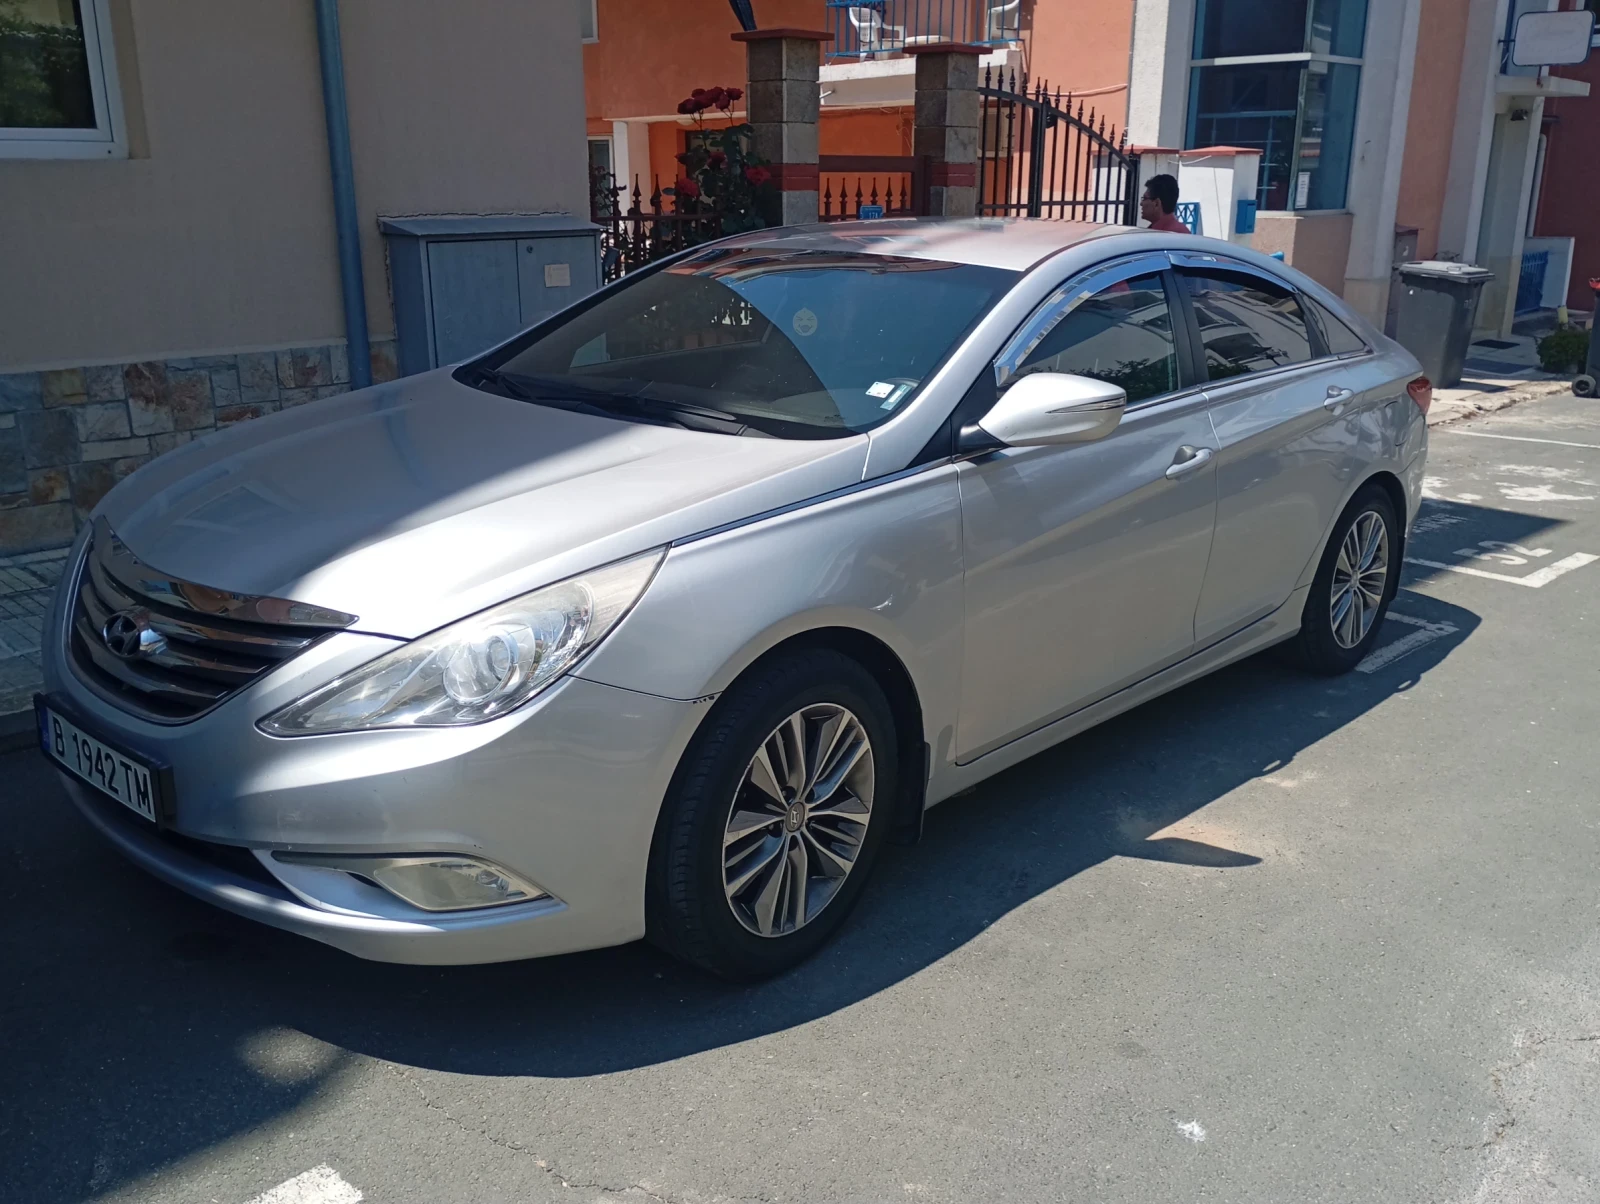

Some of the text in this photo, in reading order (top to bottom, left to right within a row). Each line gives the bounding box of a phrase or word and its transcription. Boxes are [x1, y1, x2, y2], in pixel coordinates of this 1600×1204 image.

[52, 715, 152, 814] B 1942 TM
